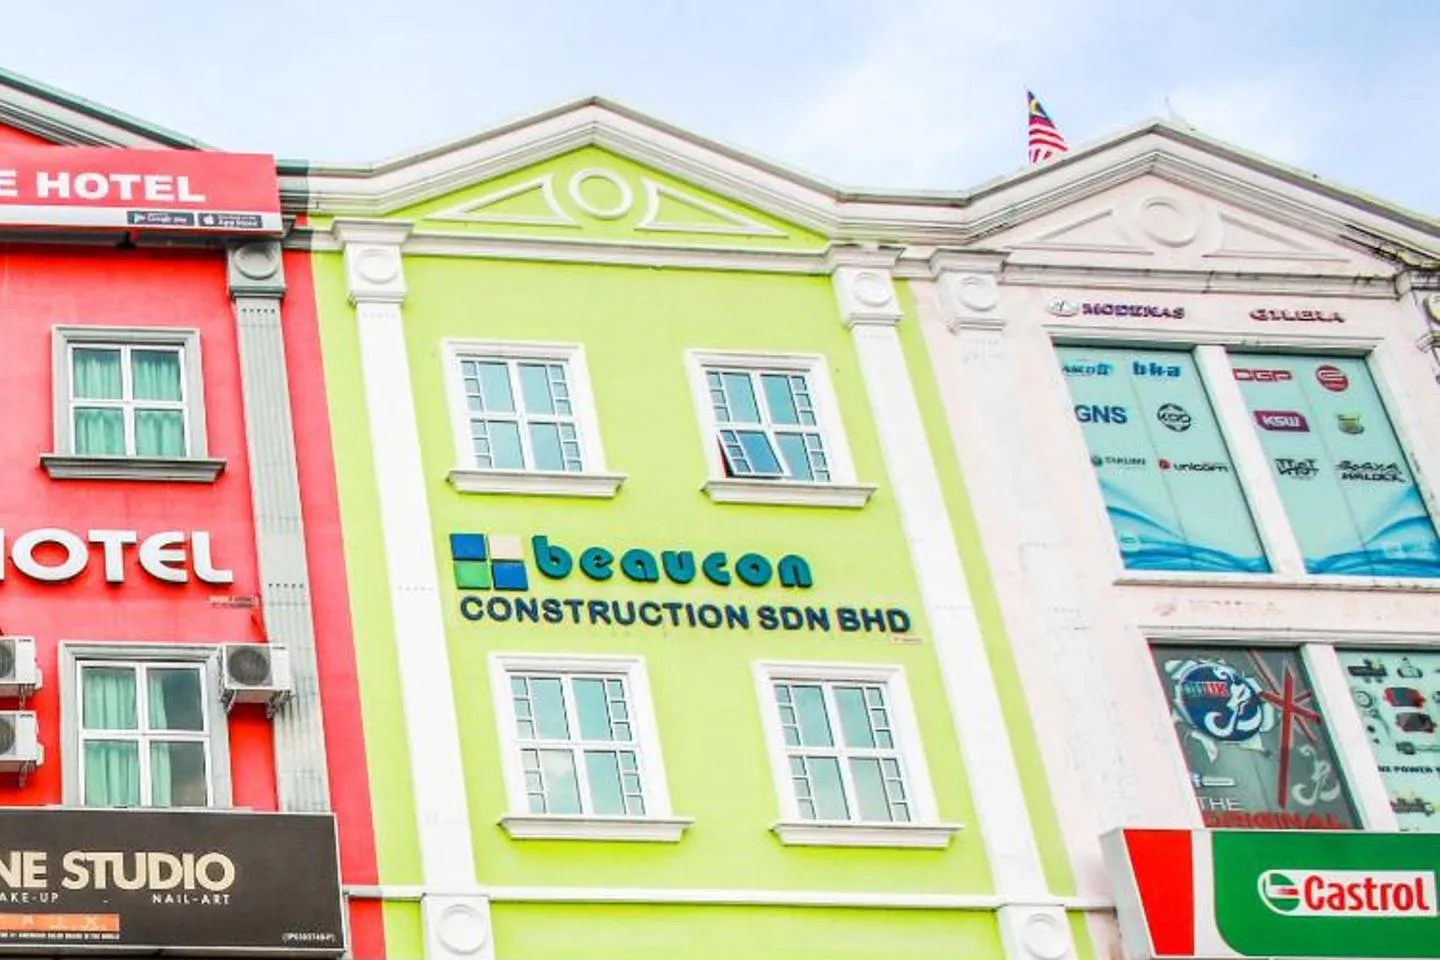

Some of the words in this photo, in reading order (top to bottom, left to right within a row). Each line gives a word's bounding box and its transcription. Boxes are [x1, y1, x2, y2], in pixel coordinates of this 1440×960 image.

[36, 171, 206, 203] HOTEL
[1074, 404, 1128, 424] GNS
[532, 534, 814, 589] beaucon
[460, 595, 750, 630] CONSTRUCTION
[760, 605, 830, 632] SDN
[837, 607, 912, 633] BHD
[61, 851, 236, 890] STUDIO
[152, 893, 231, 906] NAIL-ART
[1304, 875, 1430, 911] Castrol
